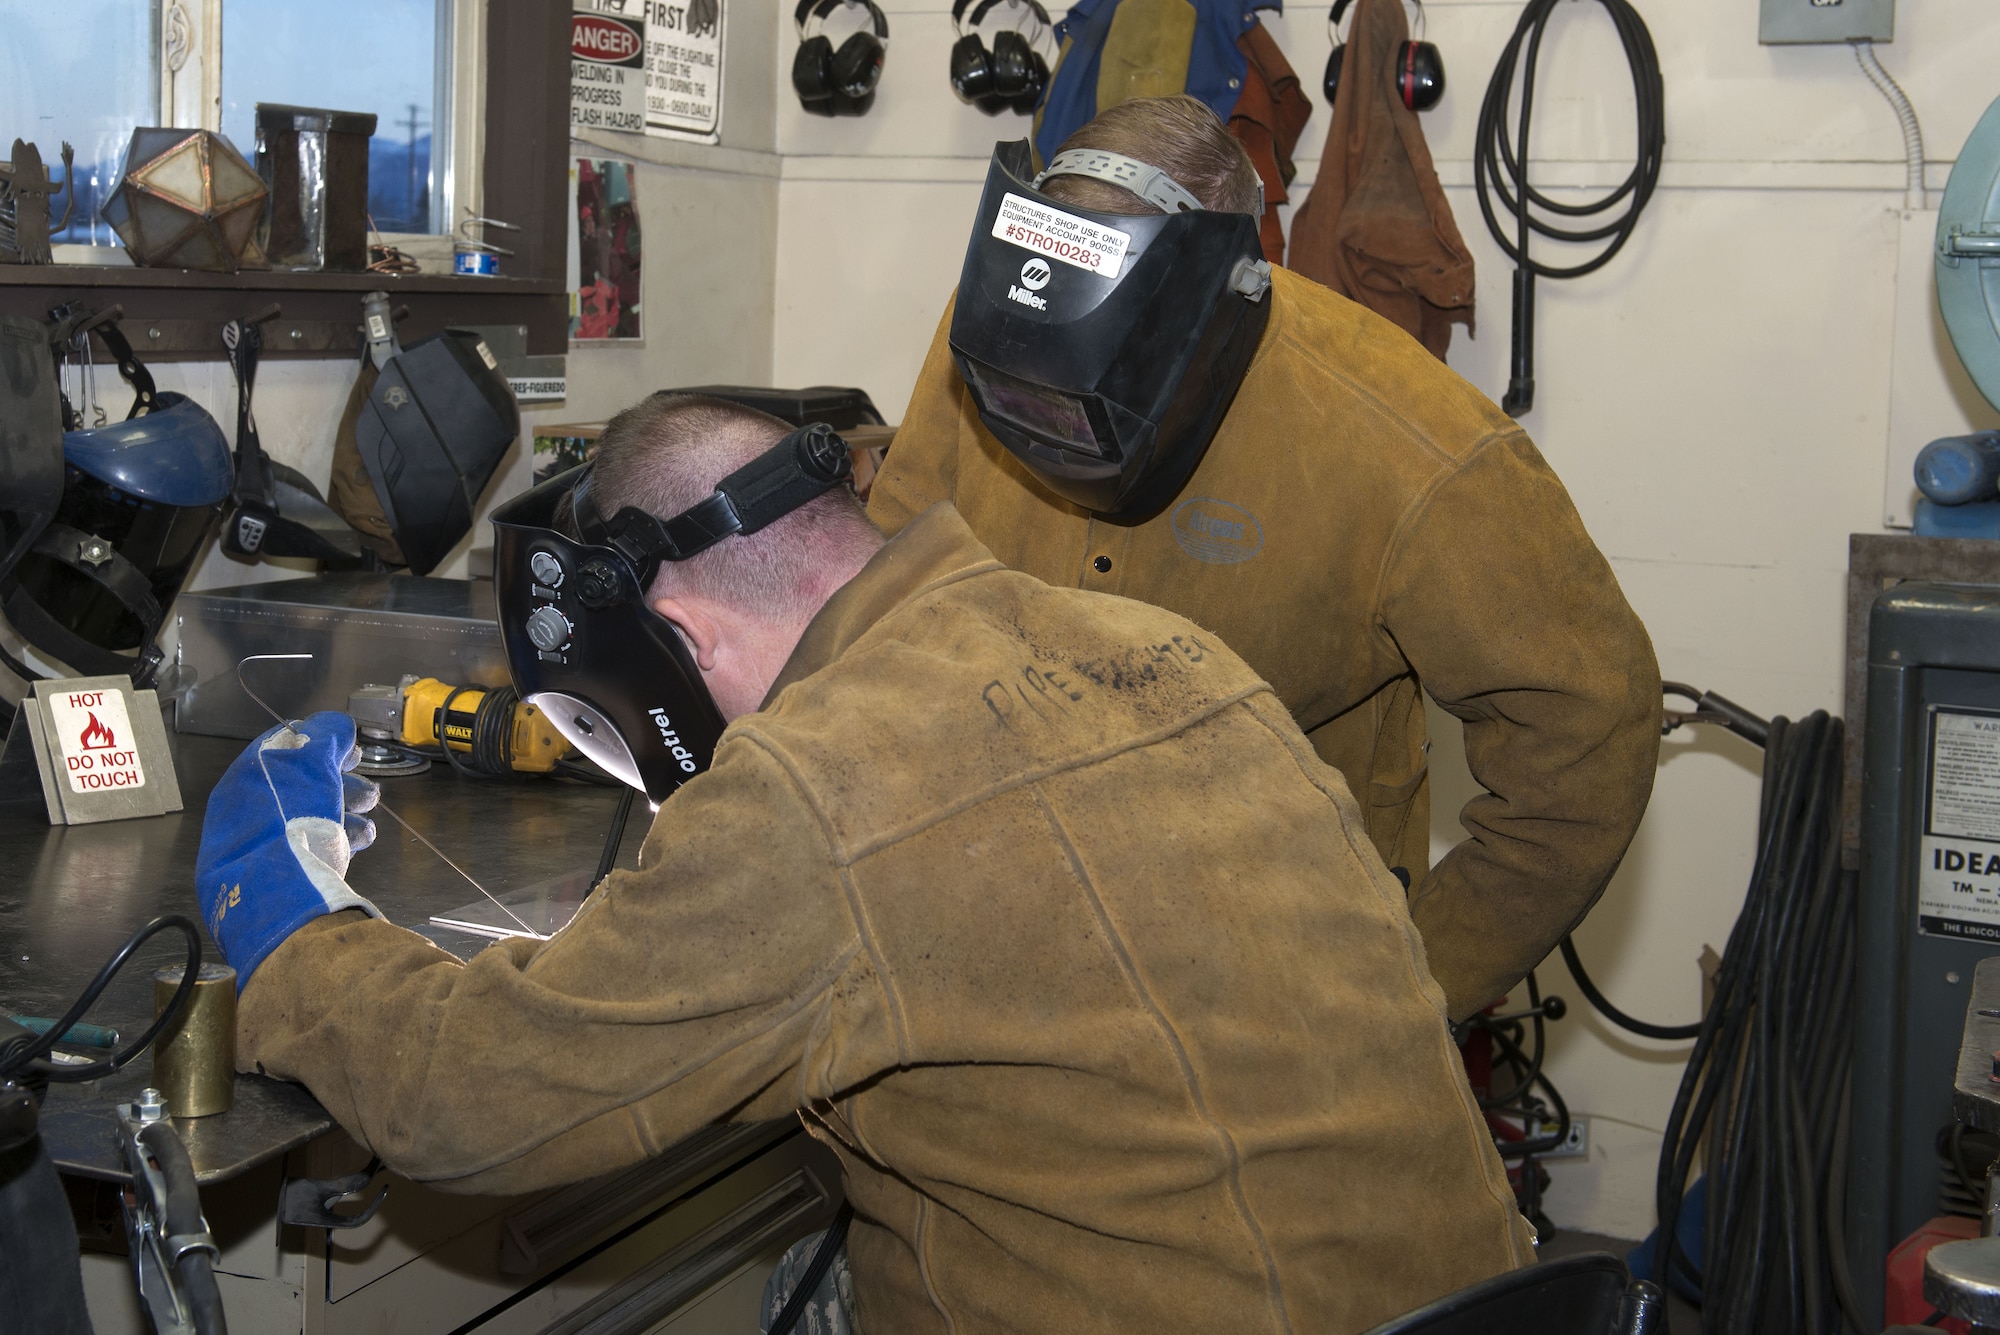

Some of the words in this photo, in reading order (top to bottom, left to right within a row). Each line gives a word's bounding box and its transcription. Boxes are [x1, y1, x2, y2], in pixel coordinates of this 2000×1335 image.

[644, 1, 684, 31] FIRST
[572, 25, 633, 54] ANGER
[667, 45, 679, 60] THE
[571, 63, 612, 83] WELDING
[615, 69, 625, 85] IN
[658, 60, 678, 76] CLOSE
[680, 64, 692, 79] THE
[571, 85, 622, 106] PROGRESS
[655, 76, 668, 90] YOU
[669, 78, 693, 95] DURING
[694, 83, 706, 98] THE
[572, 107, 602, 126] FLASH
[605, 110, 642, 130] HAZARD
[691, 102, 713, 118] DAILY
[1002, 209, 1044, 231] EQUIPMENT
[1046, 225, 1087, 246] ACCOUNT
[1003, 200, 1053, 223] STRUCTURES
[1055, 217, 1079, 231] SHOP
[1081, 226, 1100, 240] USE
[1101, 234, 1126, 248] ONLY
[1005, 223, 1103, 268] #STR010283
[69, 692, 104, 709] HOT
[647, 707, 697, 774] optrel
[67, 755, 94, 771] DO
[101, 751, 135, 767] NOT
[77, 770, 139, 790] TOUCH
[1934, 848, 2000, 877] IDEA
[1952, 881, 1973, 894] TM
[1943, 922, 1962, 933] THE
